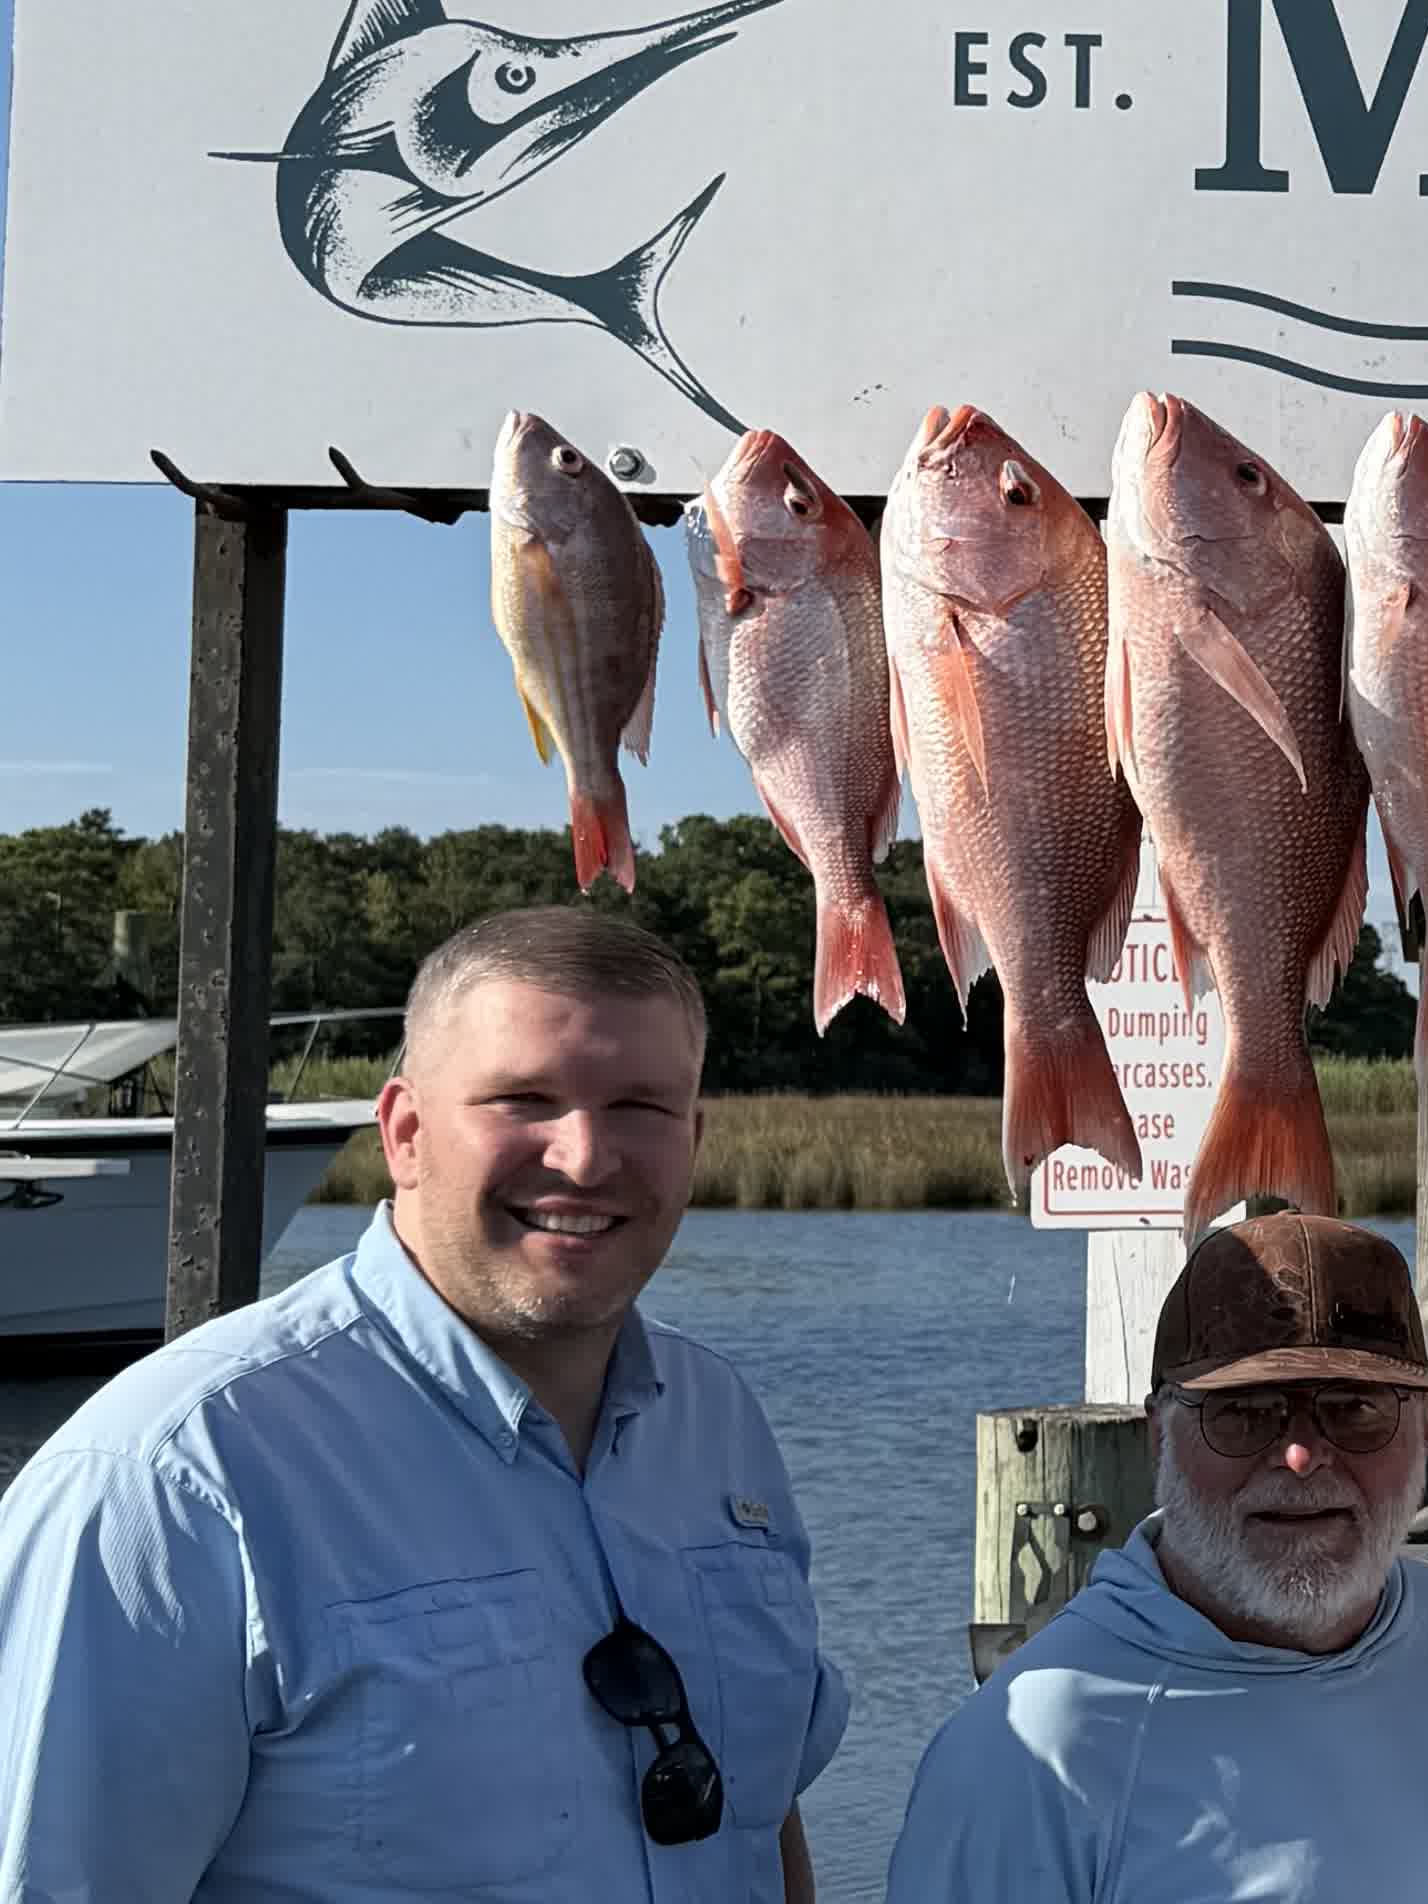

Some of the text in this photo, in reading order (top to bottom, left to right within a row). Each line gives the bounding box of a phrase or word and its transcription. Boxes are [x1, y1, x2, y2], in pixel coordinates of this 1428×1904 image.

[955, 32, 1134, 110] EST.
[1108, 1004, 1208, 1046] Dumping
[1116, 1062, 1212, 1089] rcasses.
[1137, 1113, 1175, 1139] ase
